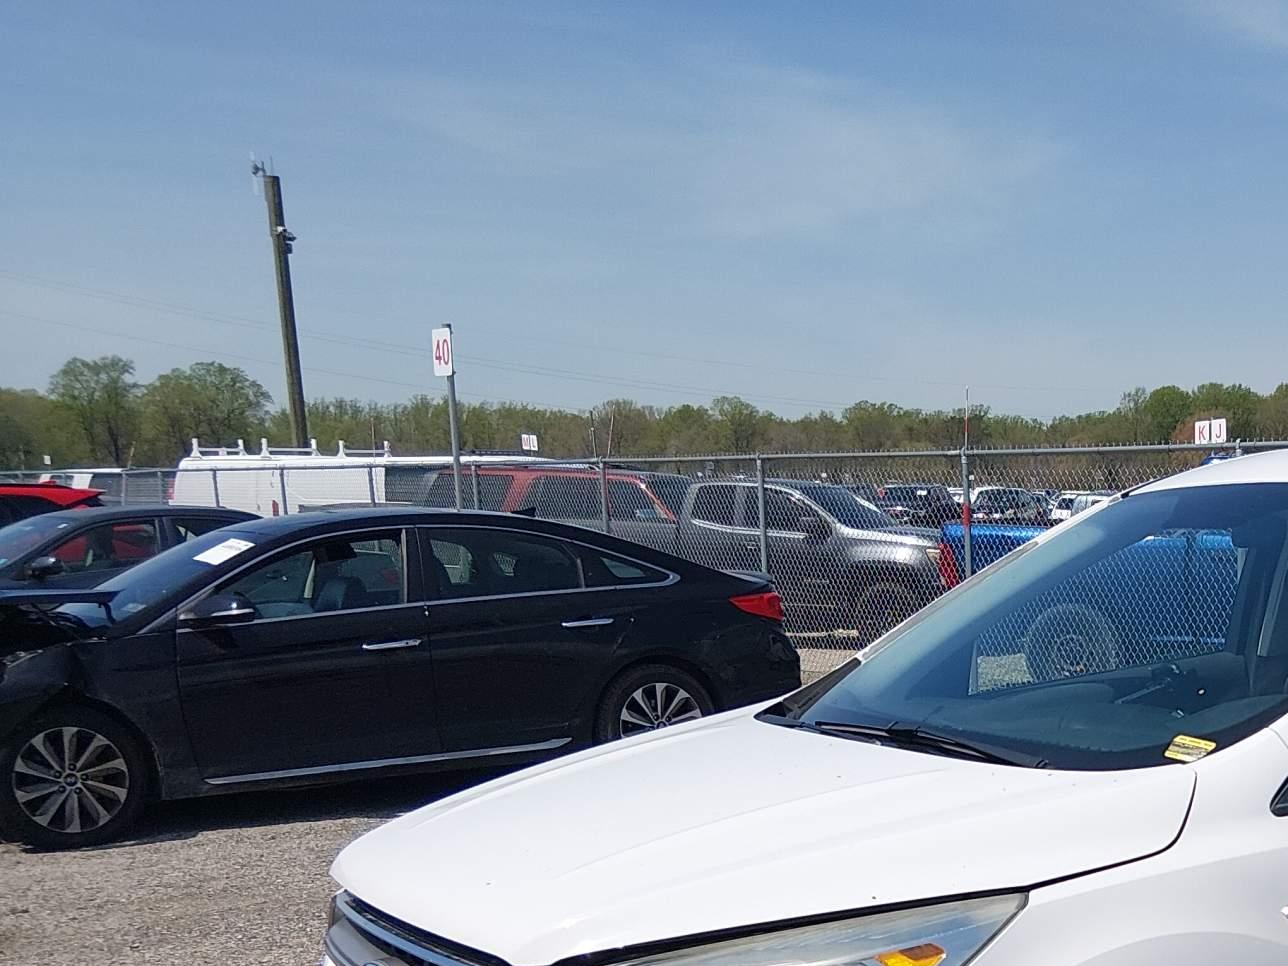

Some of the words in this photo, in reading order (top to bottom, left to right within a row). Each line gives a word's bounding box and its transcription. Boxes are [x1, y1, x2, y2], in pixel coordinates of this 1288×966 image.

[435, 338, 450, 366] 40
[1198, 425, 1207, 441] K
[1215, 423, 1222, 439] J
